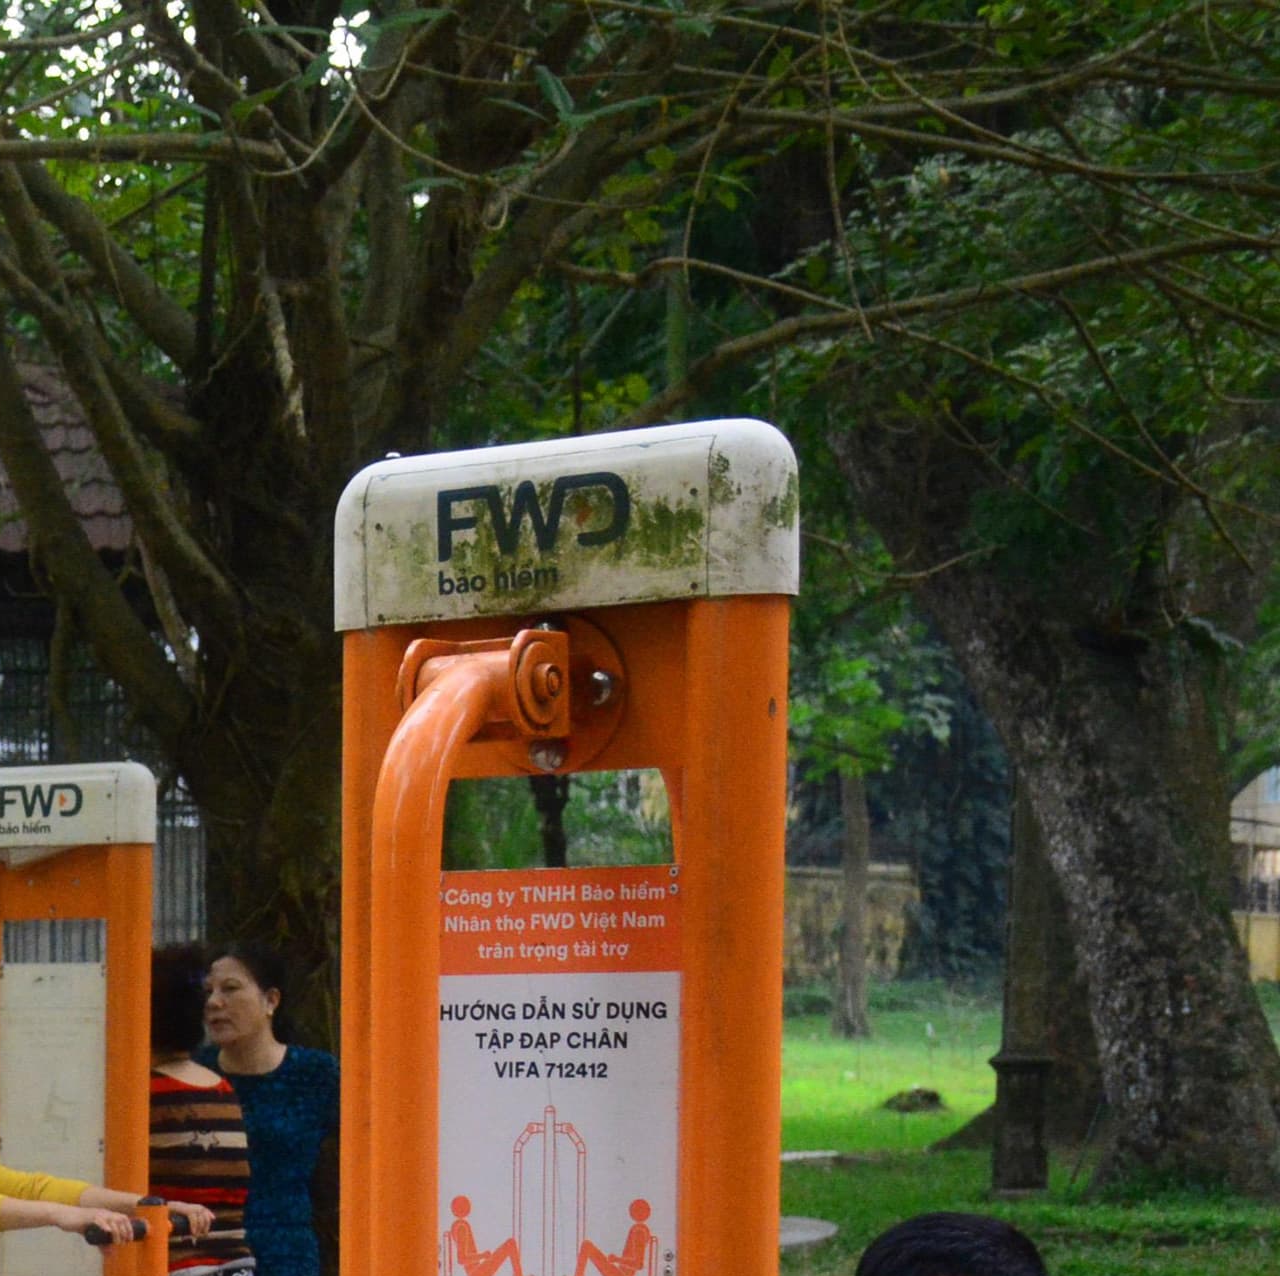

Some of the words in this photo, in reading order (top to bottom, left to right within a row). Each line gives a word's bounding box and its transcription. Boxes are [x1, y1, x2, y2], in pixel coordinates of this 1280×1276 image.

[438, 472, 630, 562] FWD
[439, 568, 486, 595] bảo
[445, 889, 492, 908] Công
[498, 890, 515, 907] ty
[521, 885, 576, 903] TNHH
[581, 884, 614, 900] Bảo
[621, 880, 665, 899] hiểm
[445, 916, 490, 932] Nhân
[496, 916, 525, 934] thọ
[531, 914, 574, 930] FWD
[580, 912, 616, 932] Việt
[623, 912, 665, 927] Nam
[479, 943, 514, 958] trân
[520, 943, 568, 961] trọng
[574, 941, 596, 957] tài
[602, 941, 629, 960] trợ
[441, 1000, 516, 1020] HƯỚNG
[523, 996, 565, 1019] DẪN
[572, 997, 600, 1019] SỬ
[607, 1002, 667, 1024] DỤNG
[476, 1029, 514, 1054] TẬP
[520, 1032, 560, 1054] ĐẠP
[567, 1028, 627, 1049] CHÂN
[495, 1062, 540, 1078] VIFA
[546, 1063, 607, 1078] 712412
